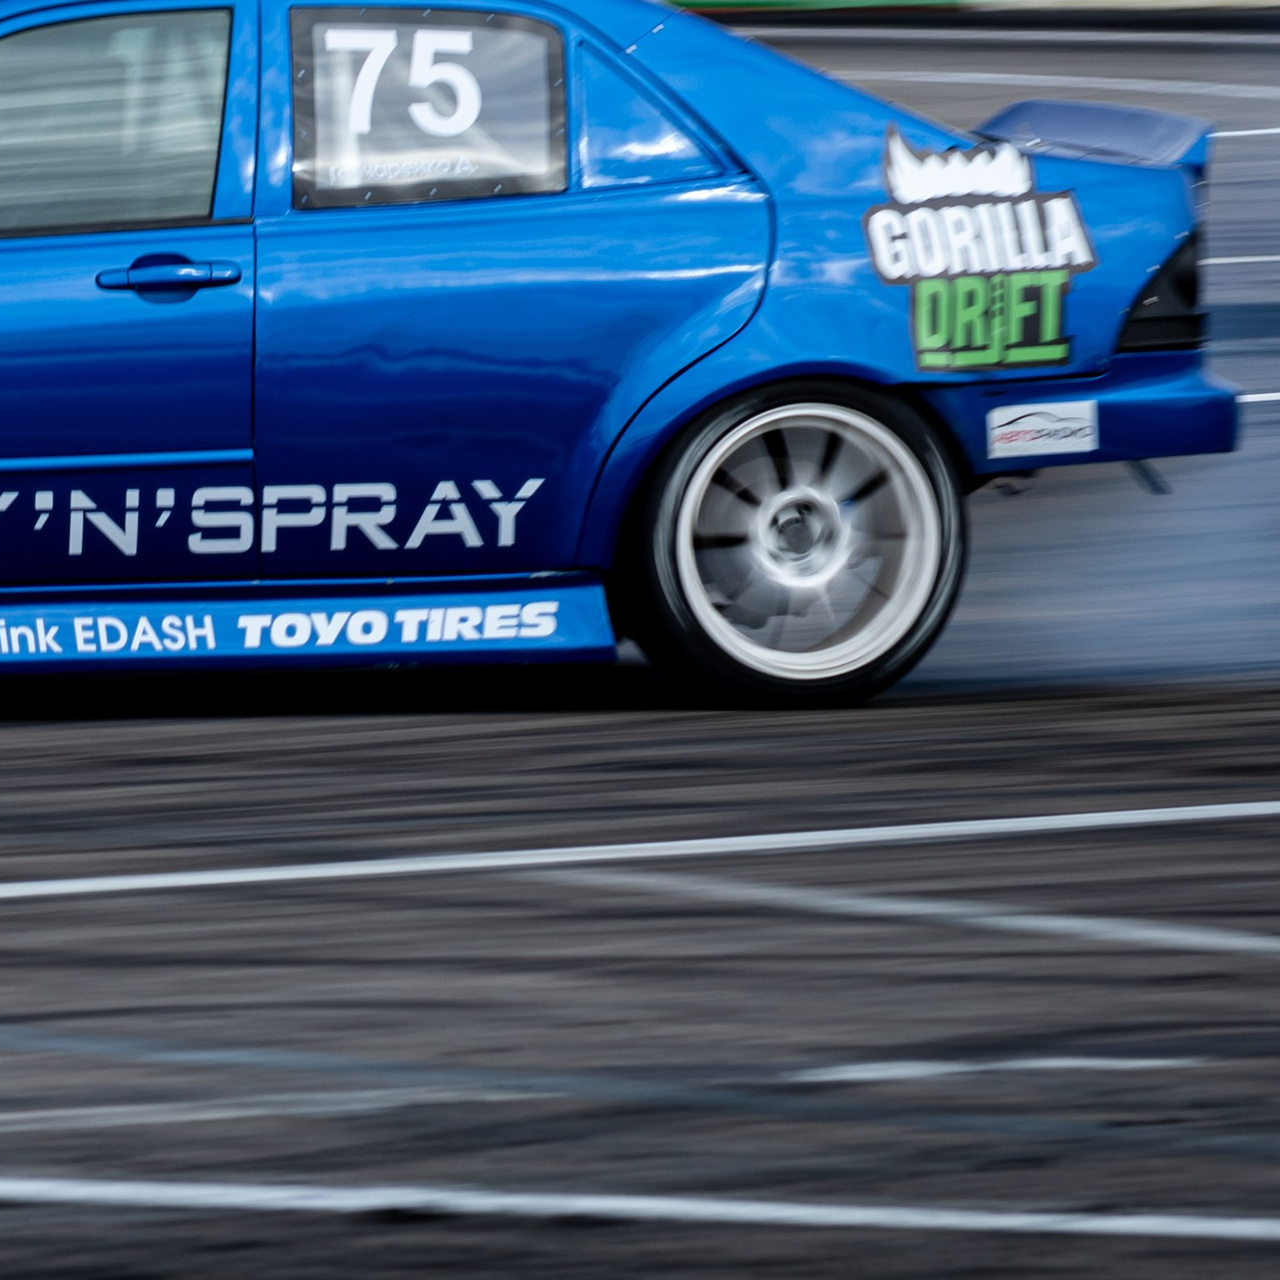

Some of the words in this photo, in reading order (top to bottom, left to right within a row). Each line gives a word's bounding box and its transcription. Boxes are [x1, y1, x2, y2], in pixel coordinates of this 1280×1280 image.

[324, 28, 482, 138] 75
[868, 195, 1095, 281] GORILLA
[917, 269, 1070, 368] DRIFT
[73, 613, 217, 652] EDASH
[237, 608, 389, 649] TOYO
[393, 601, 560, 643] TIRES
